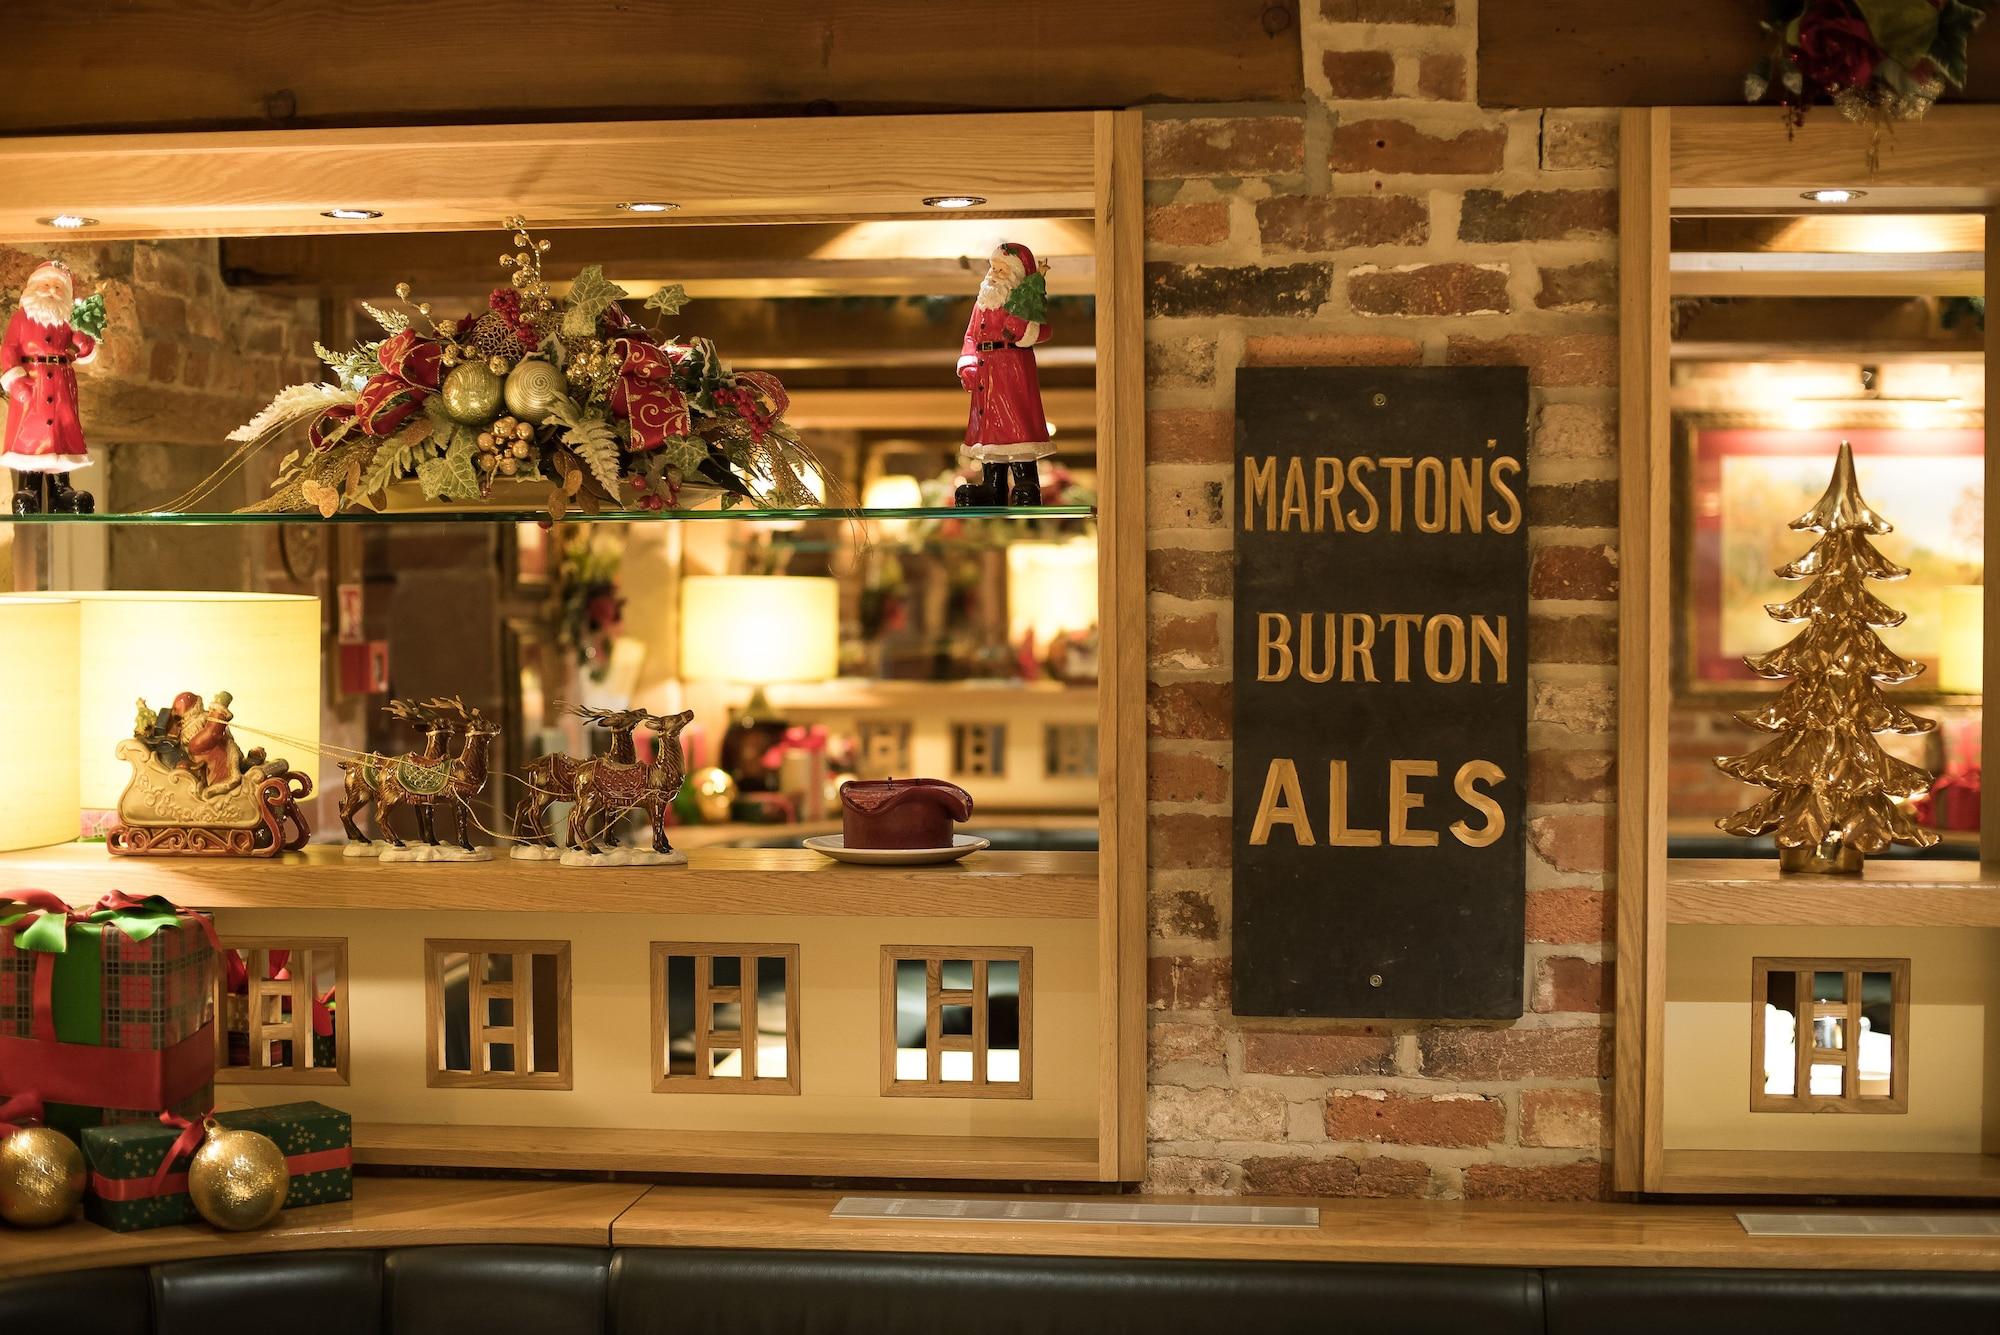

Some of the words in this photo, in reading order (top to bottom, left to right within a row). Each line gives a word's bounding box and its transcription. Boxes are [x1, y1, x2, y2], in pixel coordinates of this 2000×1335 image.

[1243, 439, 1522, 535] MARSTON'S
[1256, 612, 1509, 684] BURTON
[1248, 758, 1507, 848] ALES
